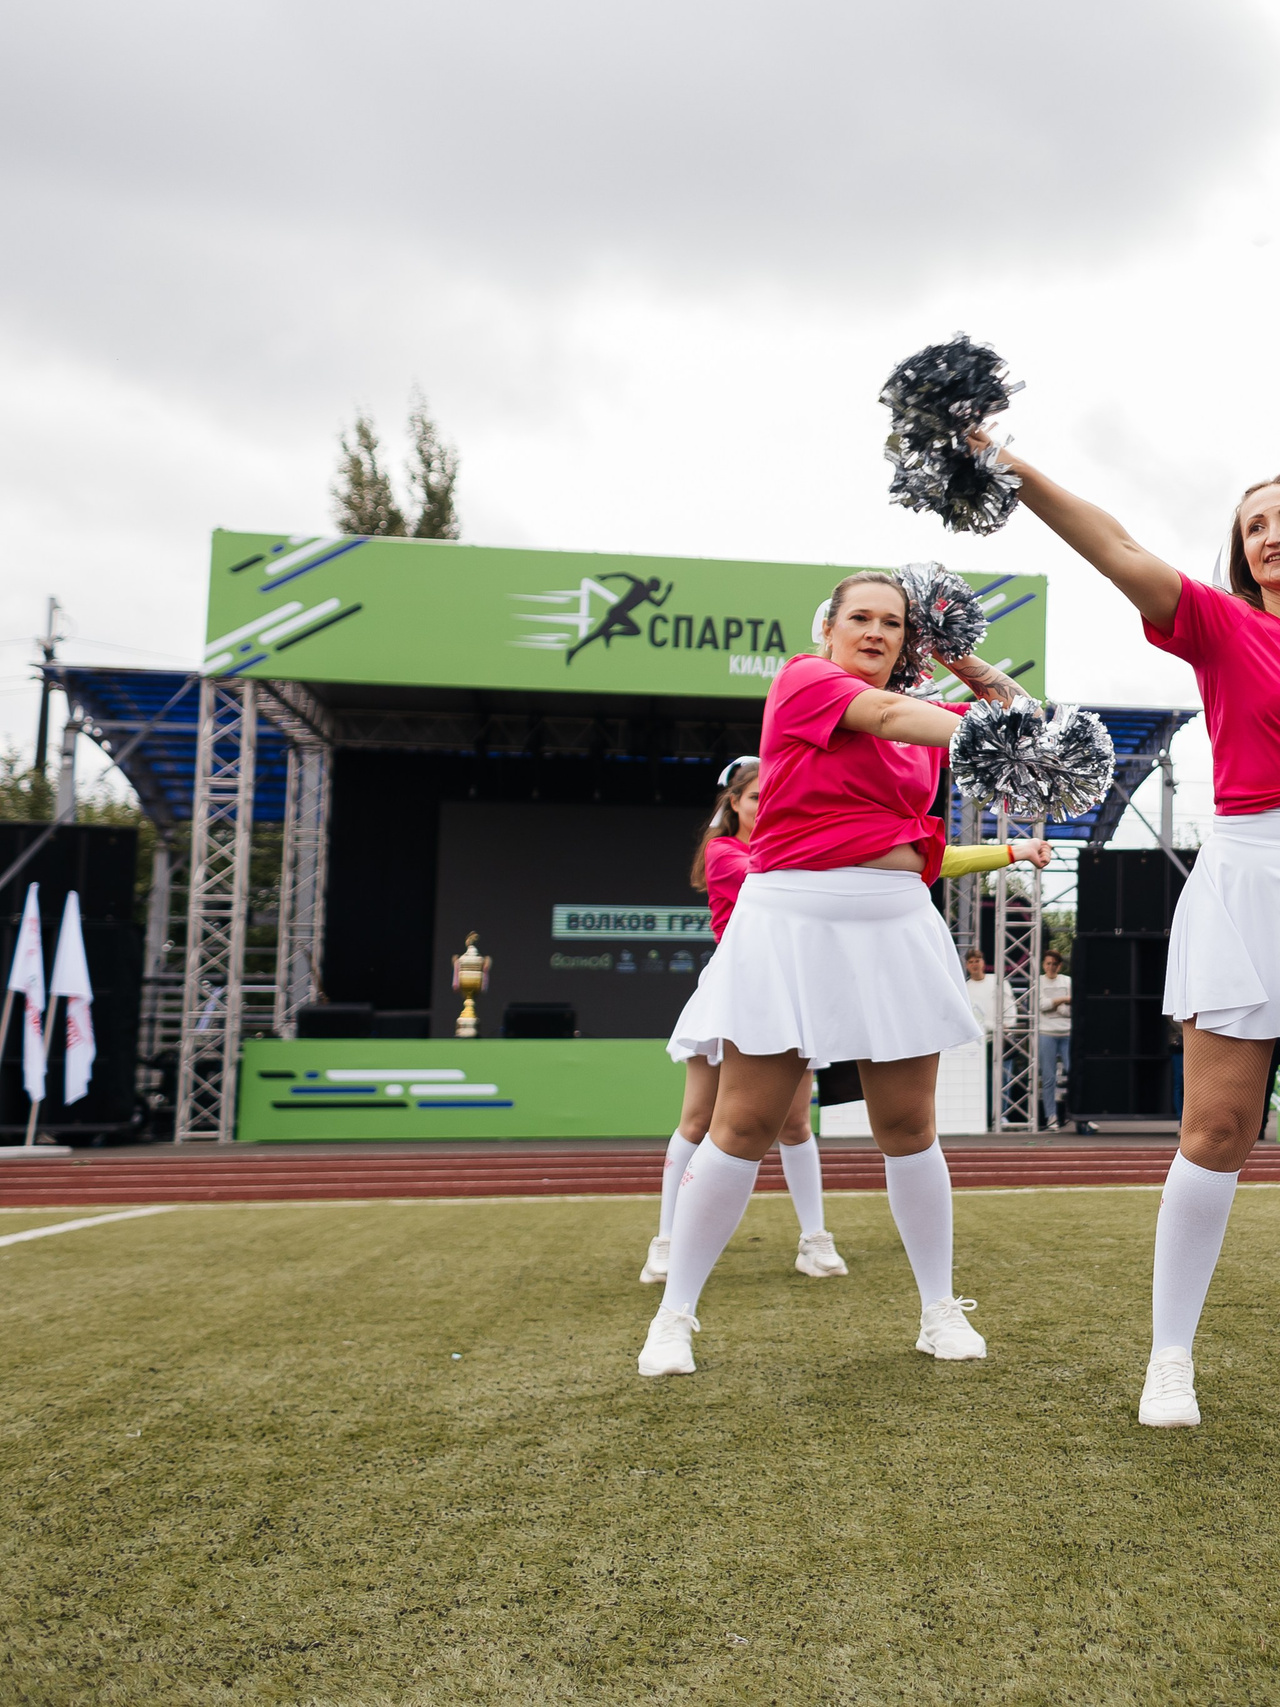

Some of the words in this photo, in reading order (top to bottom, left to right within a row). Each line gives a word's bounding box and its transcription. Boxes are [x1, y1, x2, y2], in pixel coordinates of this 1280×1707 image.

[649, 613, 787, 652] СПАРТА
[567, 914, 657, 930] ВОЛКОВ
[668, 914, 711, 931] ГРУ
